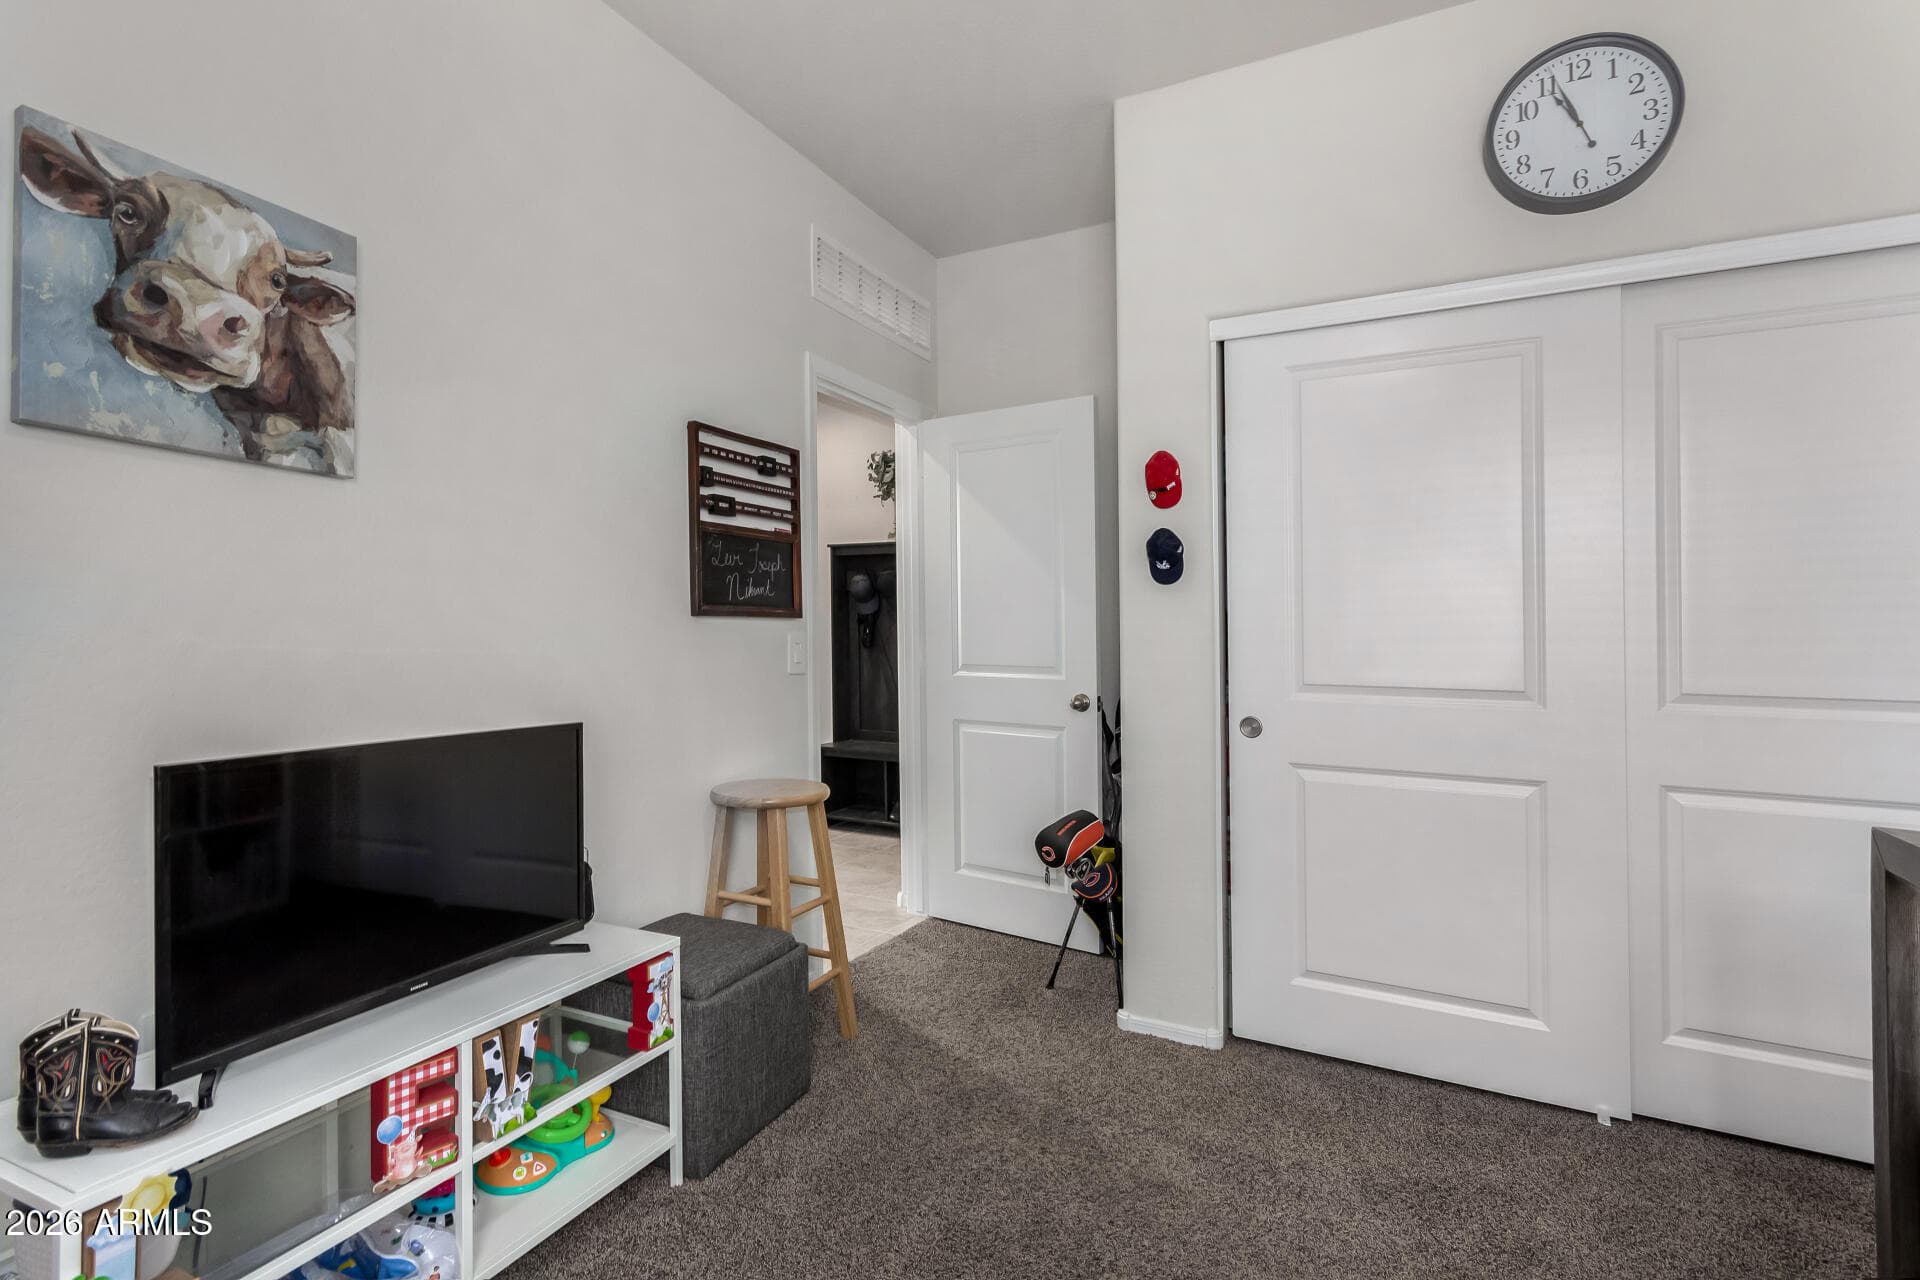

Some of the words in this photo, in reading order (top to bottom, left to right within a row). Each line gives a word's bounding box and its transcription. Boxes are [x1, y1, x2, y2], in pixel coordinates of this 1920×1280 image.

[1564, 58, 1592, 83] 12
[1607, 58, 1618, 80] 1
[1537, 75, 1558, 98] 11
[1628, 72, 1646, 95] 2
[1514, 100, 1539, 123] 10
[1643, 98, 1660, 121] 3
[1505, 130, 1520, 150] 9
[1630, 129, 1647, 150] 4
[1516, 155, 1531, 175] 8
[1606, 155, 1622, 176] 5
[1540, 167, 1555, 188] 7
[1573, 169, 1589, 189] 6
[472, 1014, 541, 1142] V
